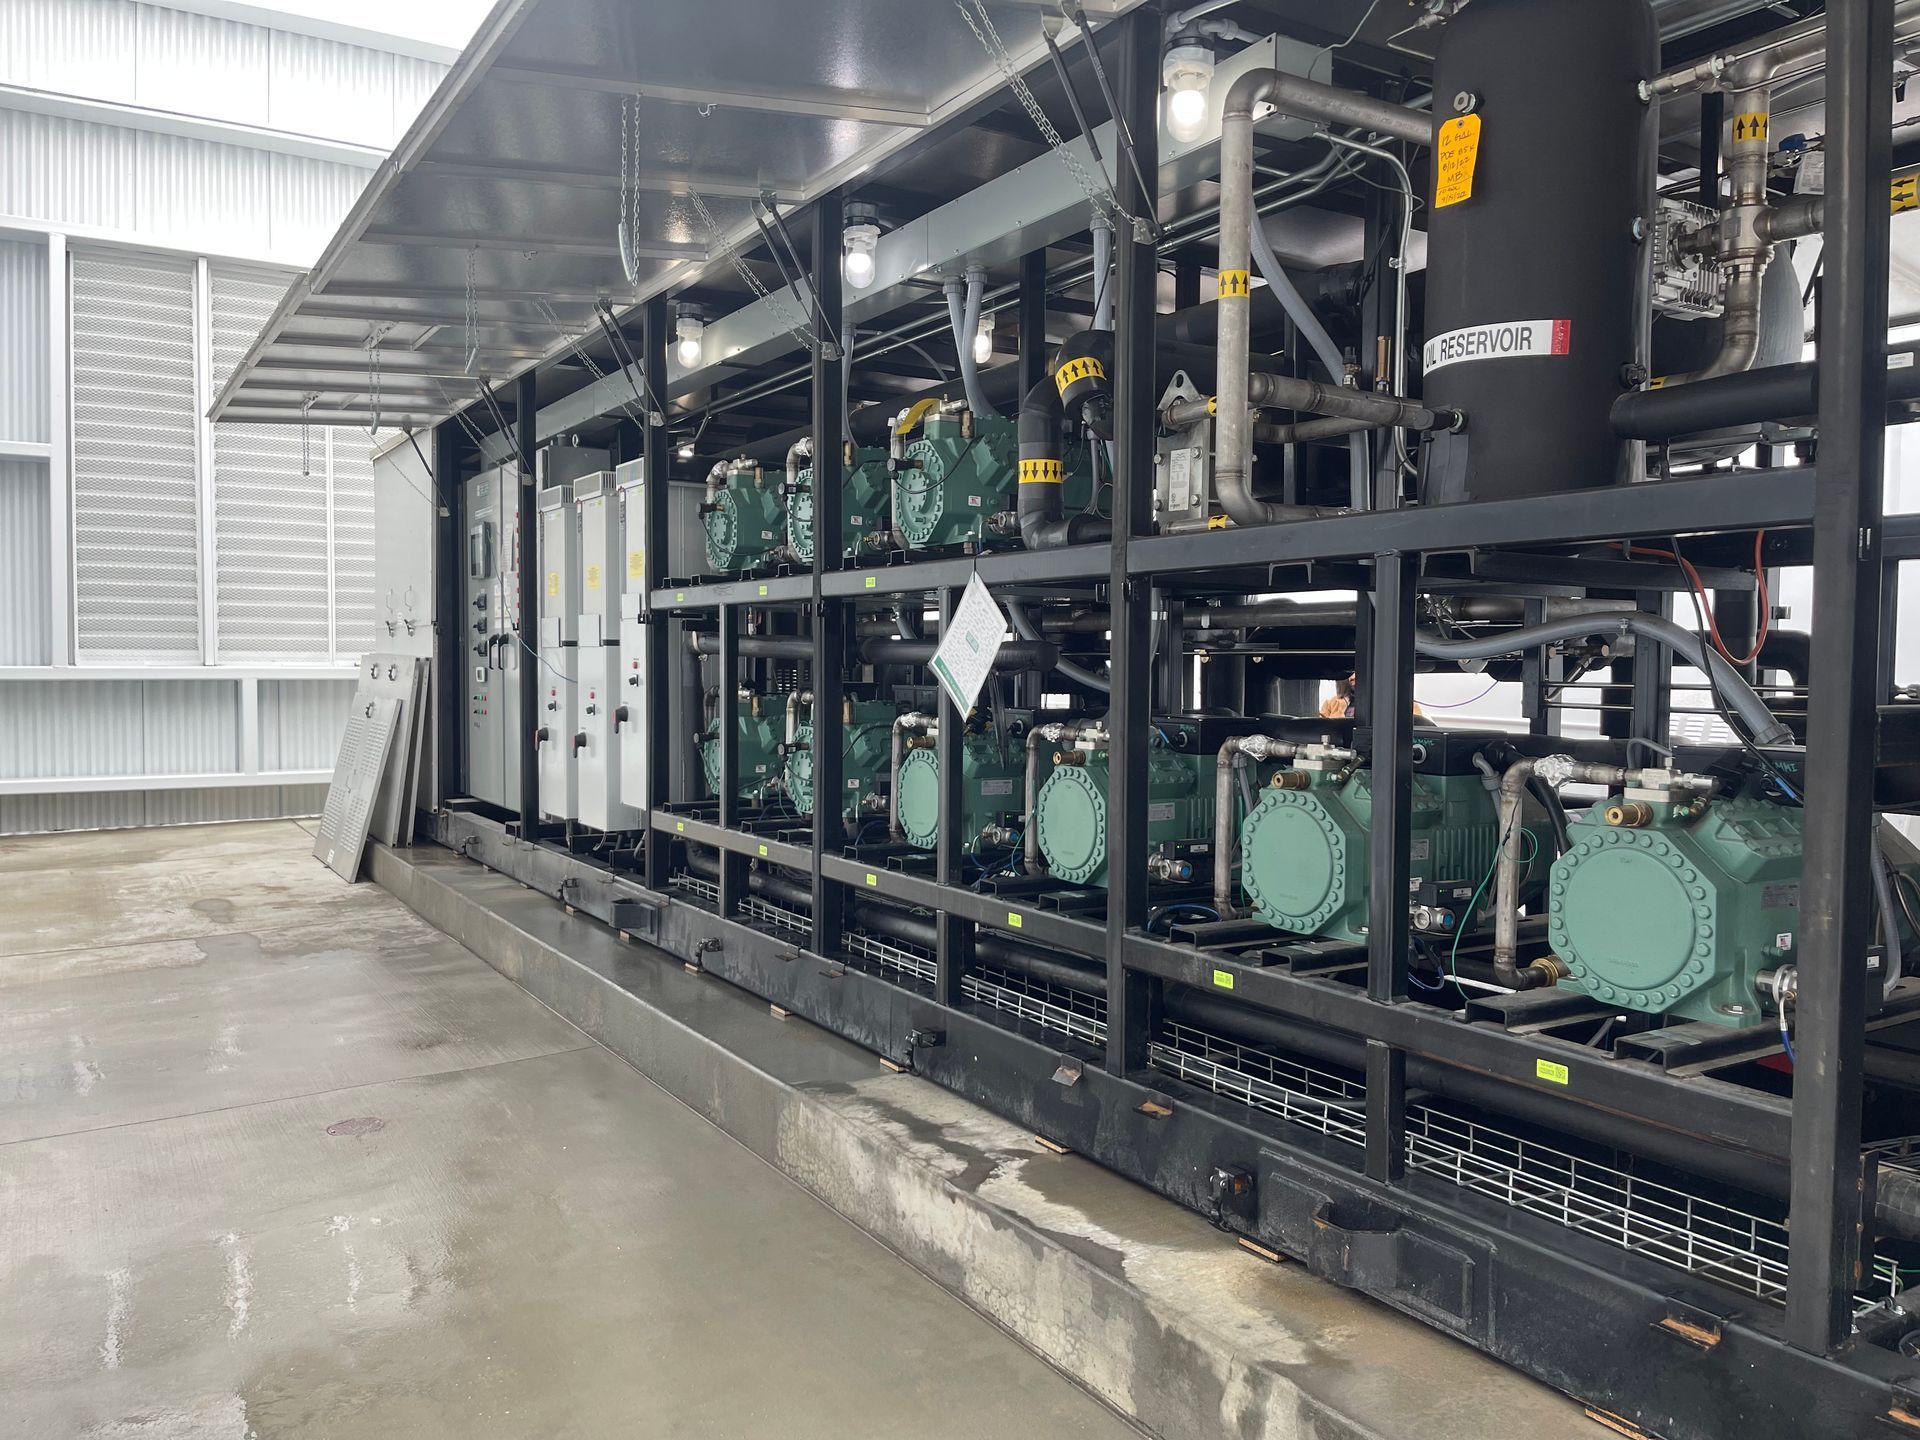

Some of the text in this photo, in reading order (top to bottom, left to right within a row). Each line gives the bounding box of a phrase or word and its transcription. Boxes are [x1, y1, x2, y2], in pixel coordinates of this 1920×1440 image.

[1443, 136, 1451, 147] 12
[1425, 344, 1436, 368] OIL
[1440, 326, 1532, 361] RESERVOIR
